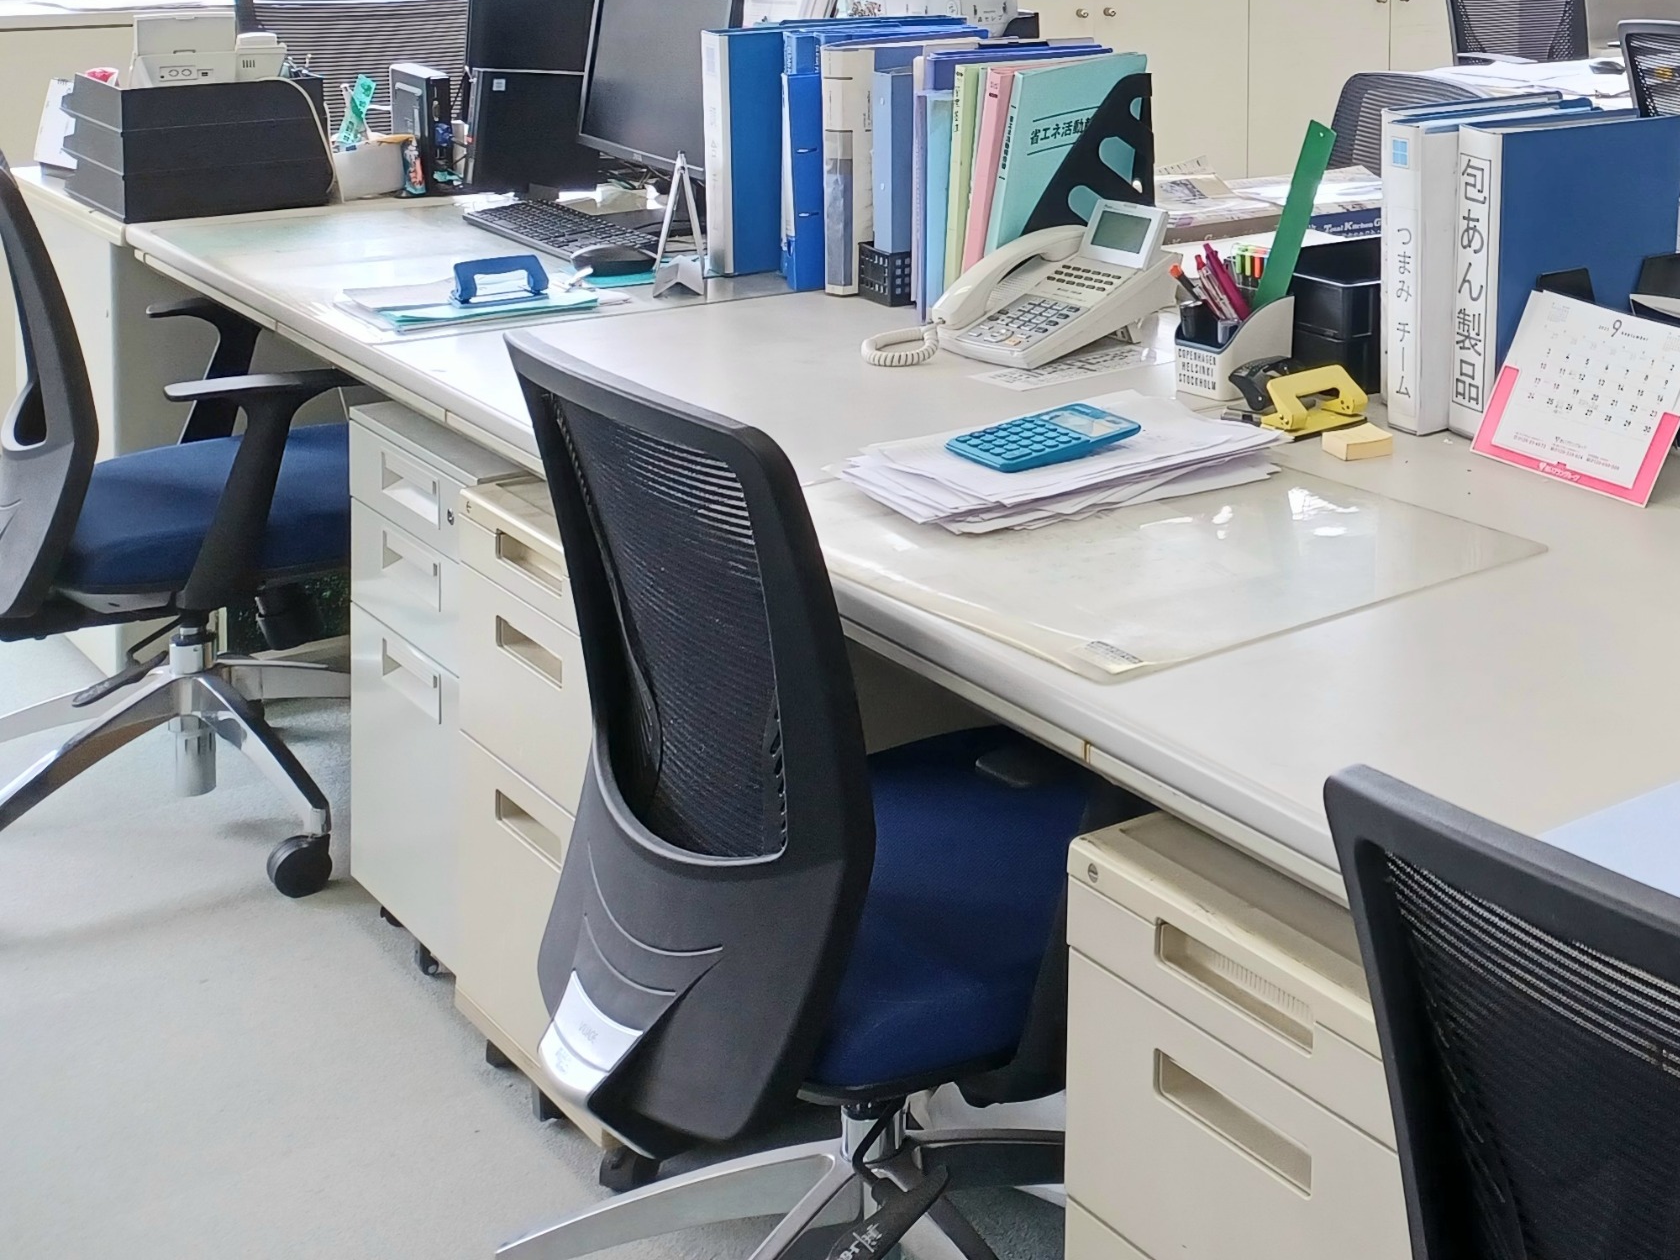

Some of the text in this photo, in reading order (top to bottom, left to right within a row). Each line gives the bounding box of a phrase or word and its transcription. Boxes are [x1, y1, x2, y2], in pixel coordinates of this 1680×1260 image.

[1456, 158, 1487, 406] 包あん製品
[1396, 227, 1412, 399] つまみ チーム
[1611, 320, 1622, 338] 9
[1178, 348, 1216, 366] COPENHAGEN
[1182, 362, 1214, 378] HELSINKI
[1178, 374, 1216, 391] STOCKHOLM
